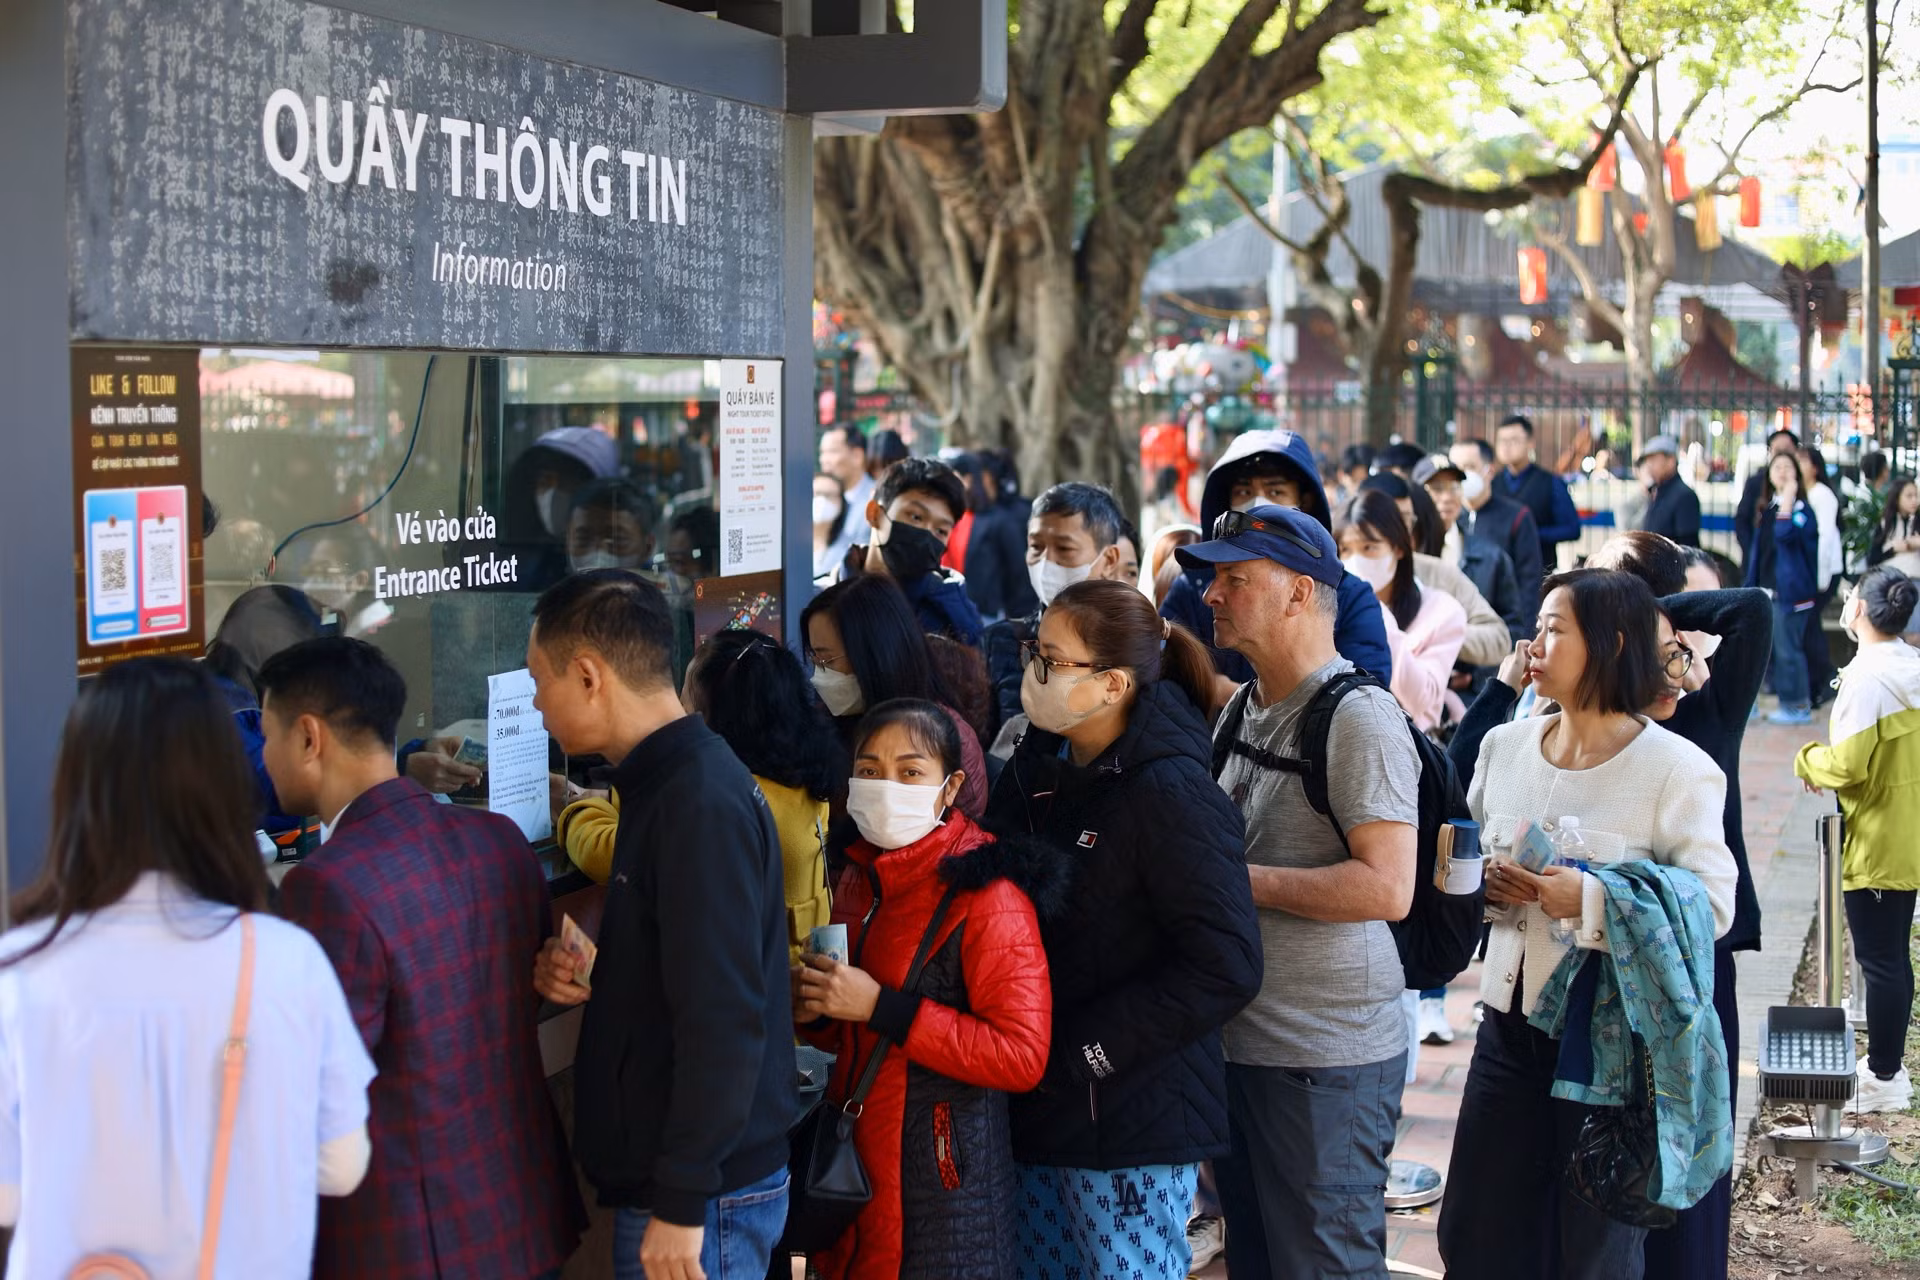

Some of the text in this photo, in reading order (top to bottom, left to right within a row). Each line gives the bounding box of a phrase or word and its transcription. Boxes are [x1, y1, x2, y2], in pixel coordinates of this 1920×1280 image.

[263, 79, 686, 226] QUẦY THÔNG TIN
[432, 241, 567, 292] Information
[90, 374, 177, 395] LIKE & FOLLOW
[90, 404, 115, 425] KÊNH
[150, 403, 178, 424] THÔNG
[395, 505, 496, 545] Vé vào cửa
[374, 552, 518, 599] Entrance Ticket
[1081, 1044, 1106, 1078] HILFIGE
[1114, 1173, 1147, 1216] LA
